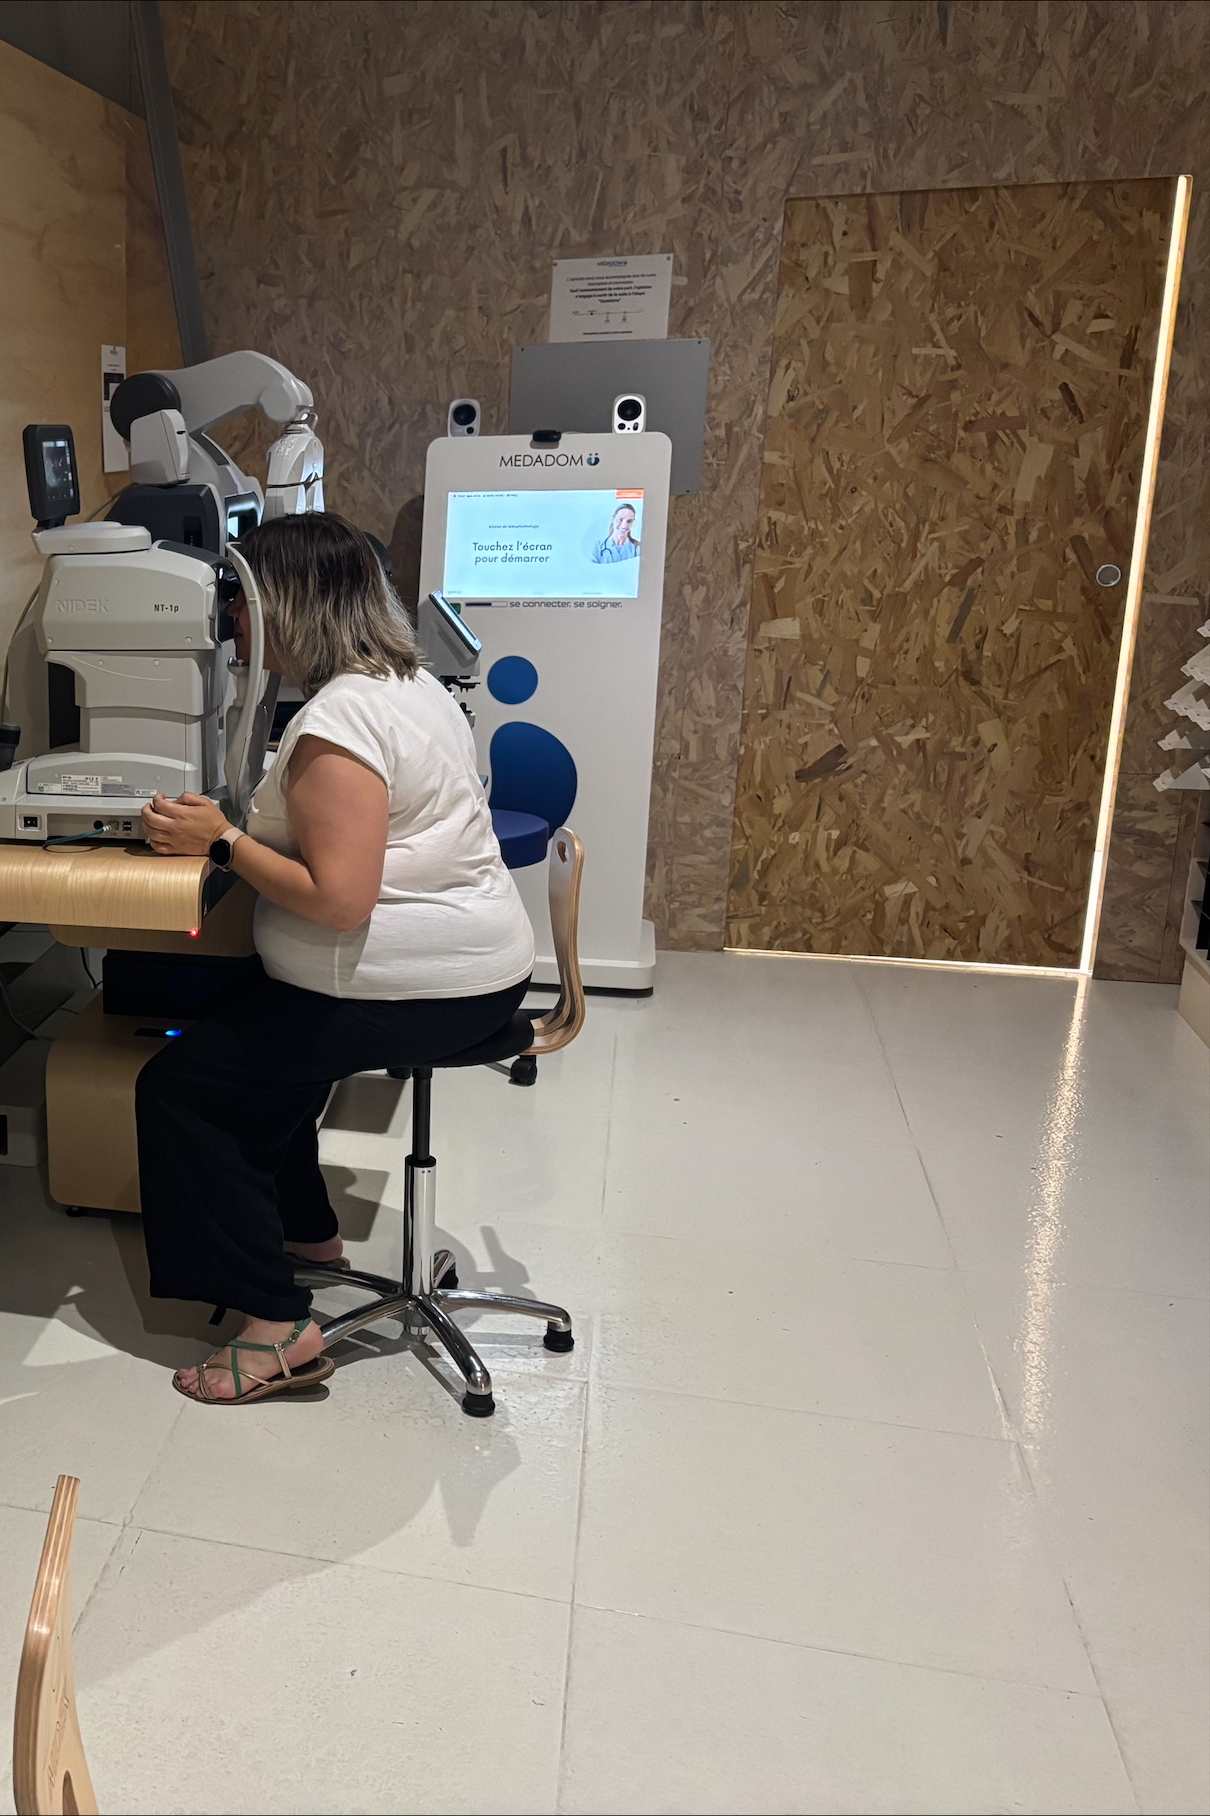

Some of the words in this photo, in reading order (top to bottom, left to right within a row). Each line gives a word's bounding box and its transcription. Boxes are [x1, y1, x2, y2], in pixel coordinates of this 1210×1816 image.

[499, 453, 583, 467] MEDADOM
[472, 540, 514, 551] Touchez
[516, 540, 553, 551] l'écran
[474, 556, 499, 566] pour
[501, 552, 550, 563] démarrer
[153, 604, 179, 613] NT-1p
[509, 600, 521, 608] se
[573, 600, 585, 608] se
